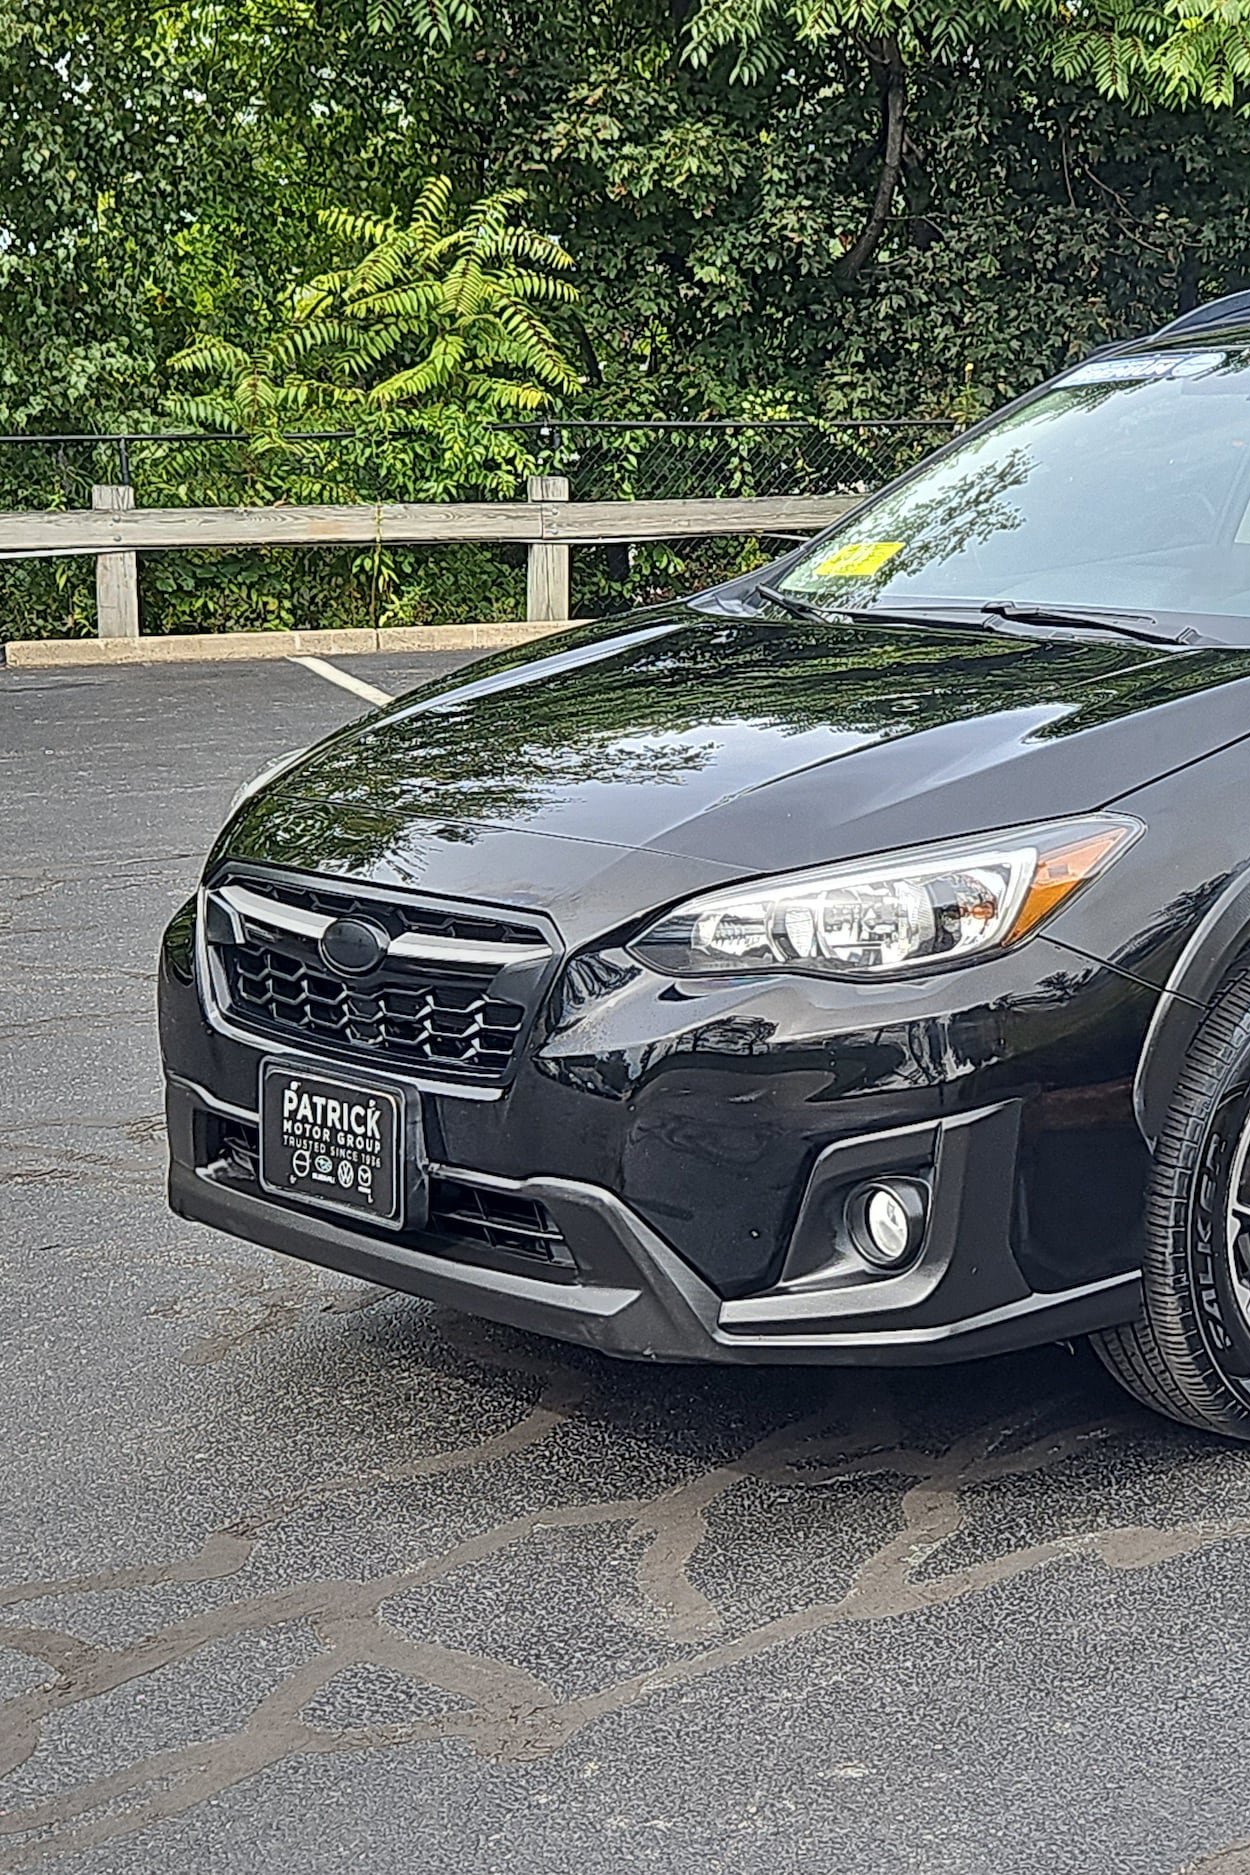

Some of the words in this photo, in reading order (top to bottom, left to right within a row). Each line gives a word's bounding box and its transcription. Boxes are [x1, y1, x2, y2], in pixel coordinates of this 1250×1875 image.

[283, 1088, 382, 1140] PATRICK
[282, 1118, 331, 1143] MOTOR
[336, 1131, 382, 1155] GROUP
[282, 1134, 327, 1155] TRUSTED
[329, 1145, 360, 1163] SINCE
